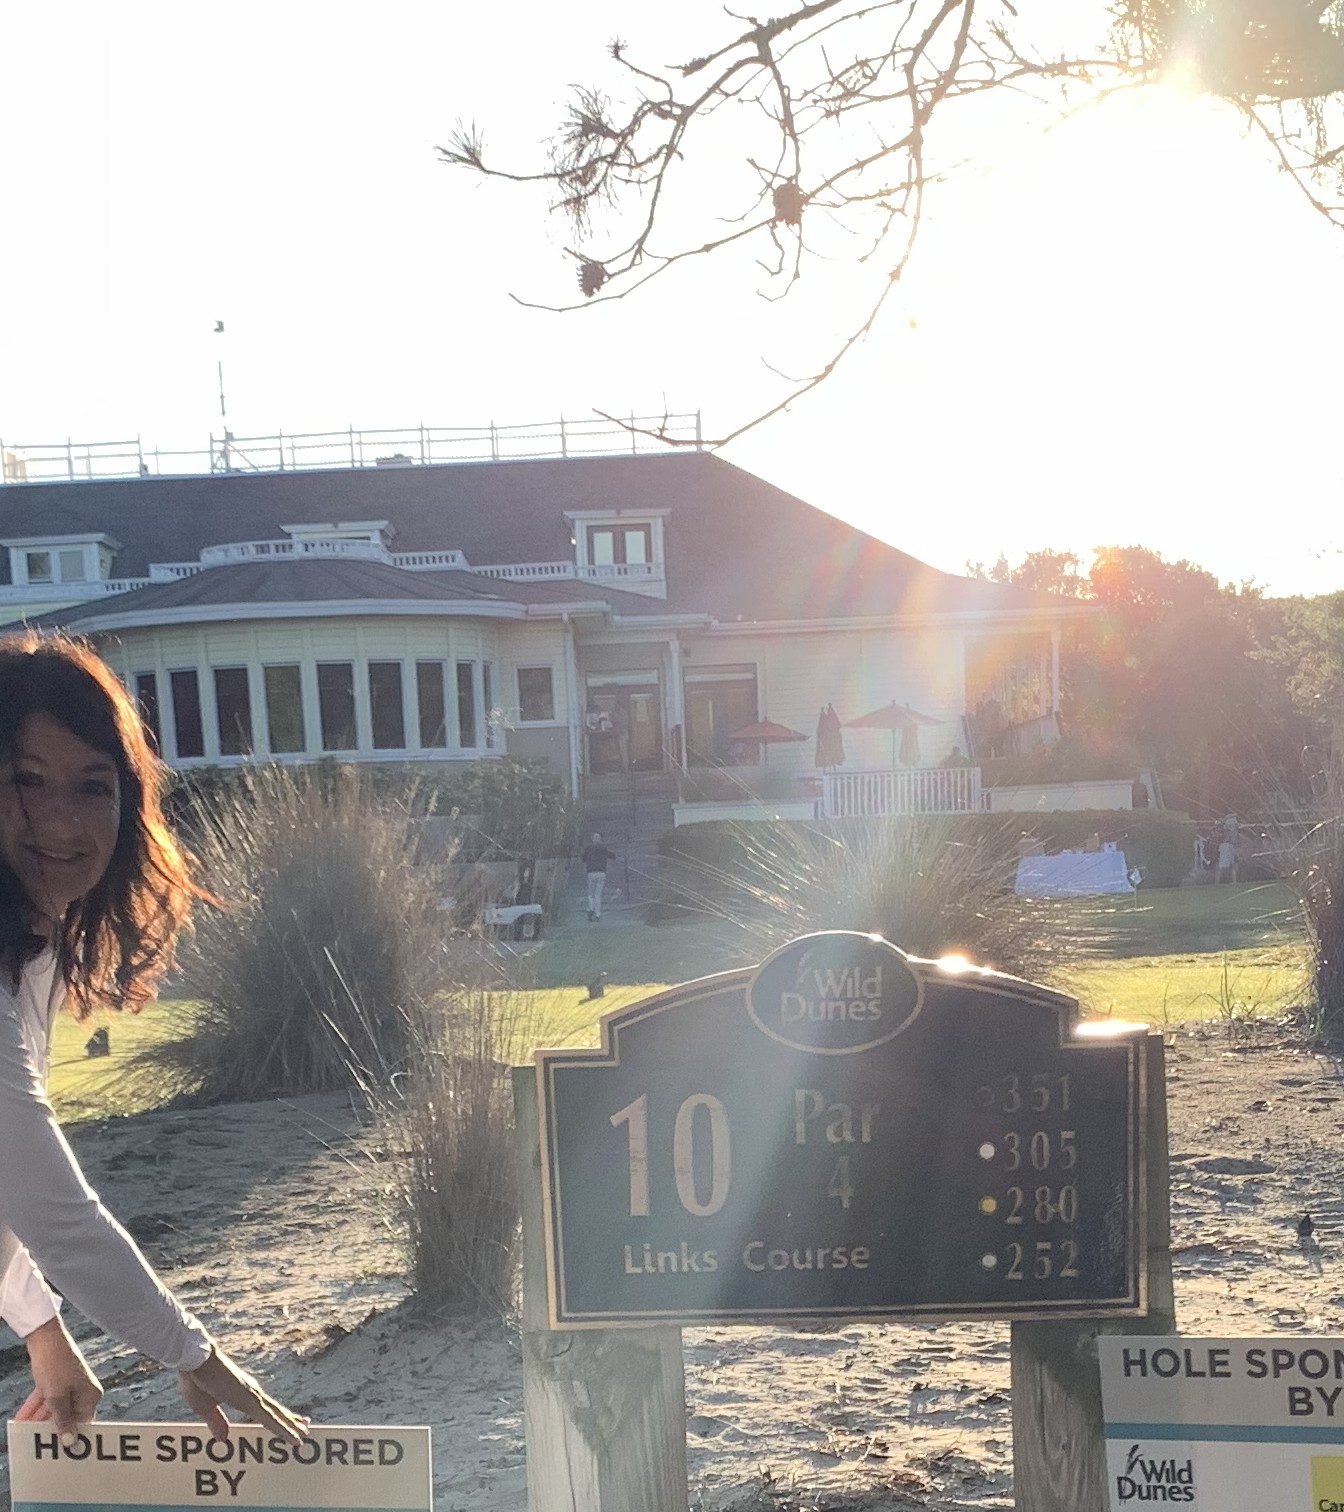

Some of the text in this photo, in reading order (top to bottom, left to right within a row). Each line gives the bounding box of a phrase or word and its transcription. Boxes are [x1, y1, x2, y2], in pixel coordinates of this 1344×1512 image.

[812, 966, 883, 998] Wild
[780, 992, 883, 1022] Dunes
[794, 1088, 882, 1144] Par
[609, 1093, 732, 1218] 10
[1003, 1130, 1077, 1170] 305
[828, 1155, 855, 1210] 4
[1005, 1185, 1078, 1225] 280
[624, 1240, 871, 1274] Links Course
[1005, 1240, 1079, 1280] 252
[1121, 1347, 1232, 1379] HOLE
[1288, 1386, 1343, 1416] BY
[34, 1433, 404, 1466] HOLE SPONSORED
[195, 1469, 246, 1497] BY
[1138, 1459, 1193, 1484] Wild
[1116, 1476, 1195, 1502] Dunes
